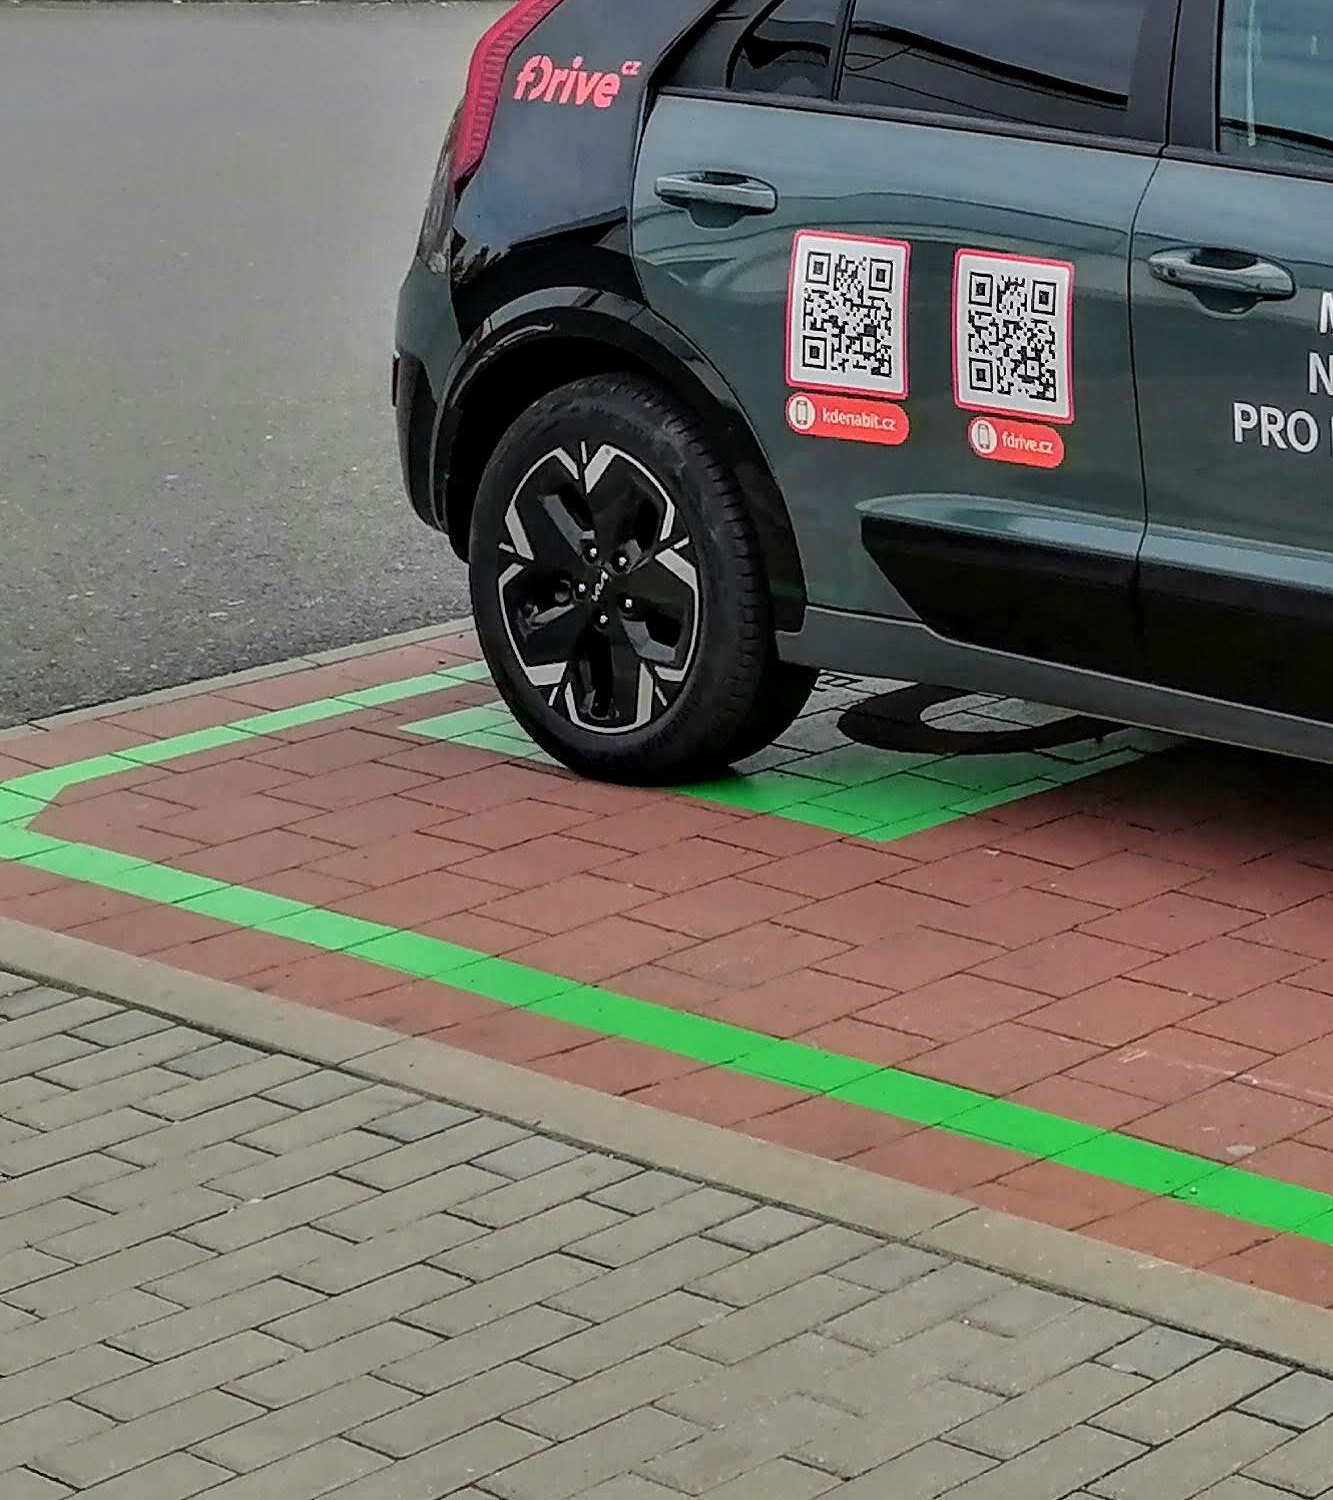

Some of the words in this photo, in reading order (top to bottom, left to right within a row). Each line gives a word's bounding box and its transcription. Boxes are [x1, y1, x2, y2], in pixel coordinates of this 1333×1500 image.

[821, 407, 897, 432] kdenabit.cz
[1233, 402, 1319, 453] PRO
[1001, 431, 1054, 454] fdrive.cz
